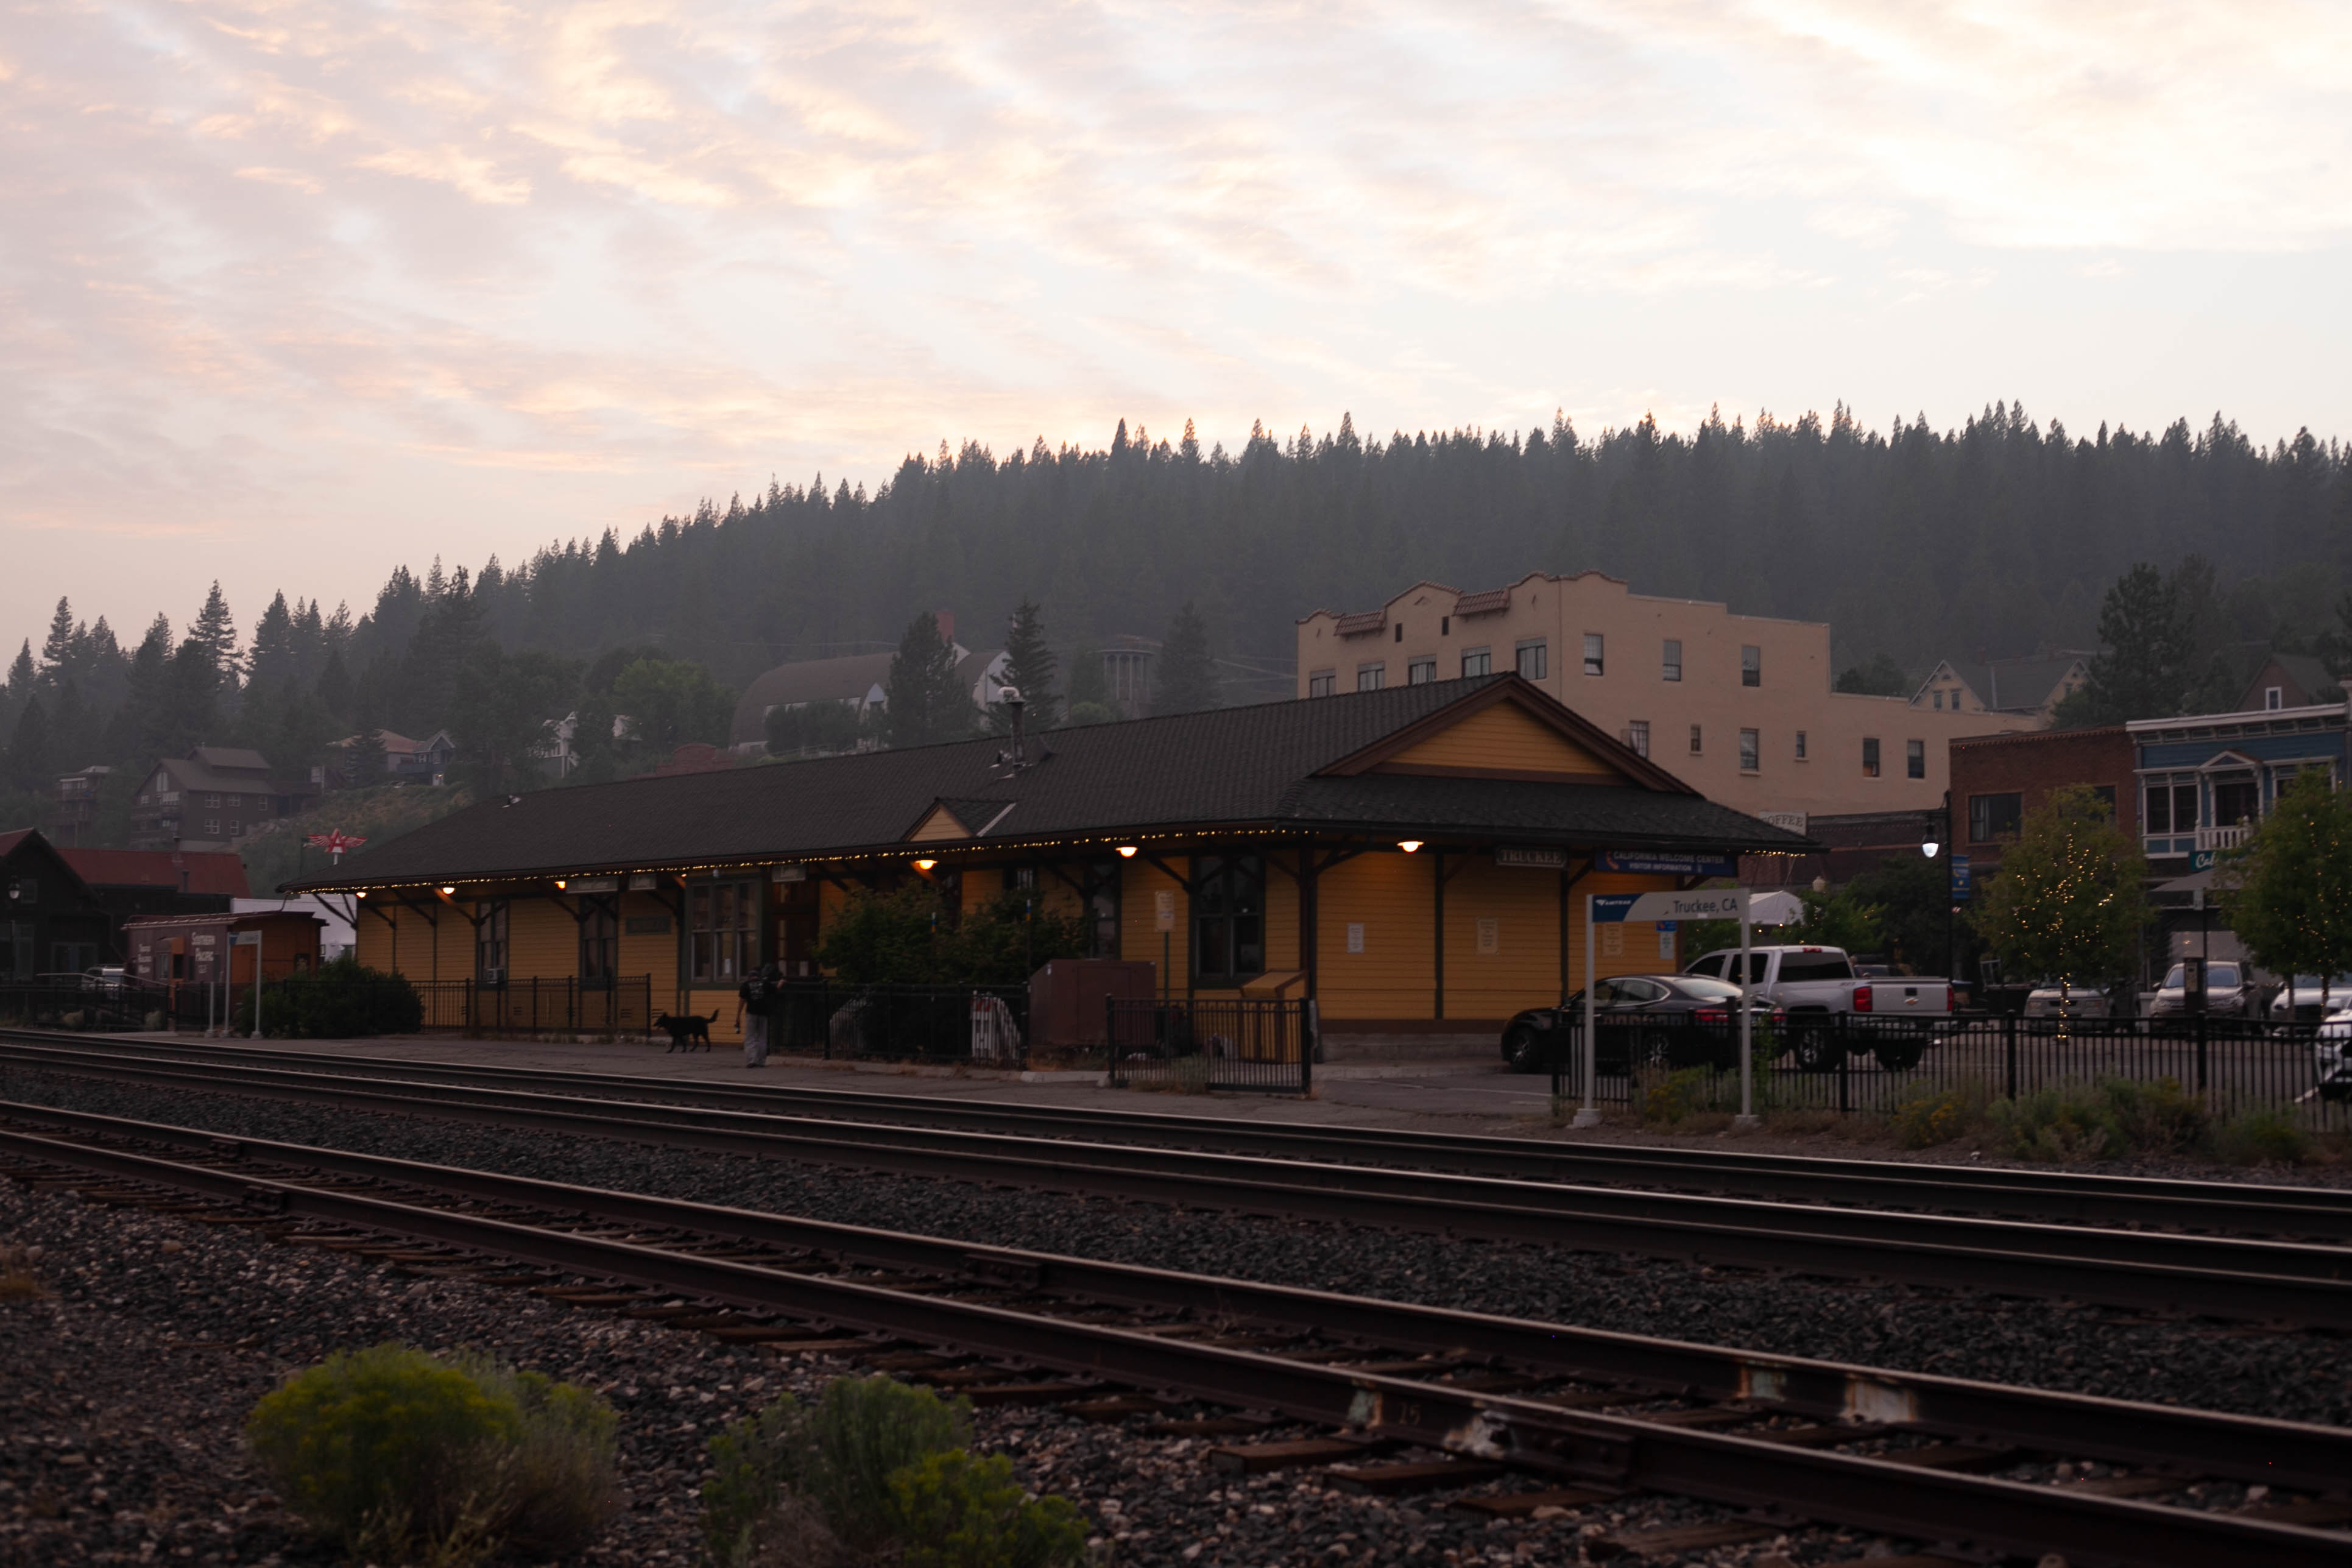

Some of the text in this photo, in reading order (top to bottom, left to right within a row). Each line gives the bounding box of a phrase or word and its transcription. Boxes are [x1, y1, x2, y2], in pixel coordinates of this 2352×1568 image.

[1763, 814, 1804, 827] OFFEE
[1501, 848, 1562, 864] TRUCKEE
[1613, 851, 1725, 864] CALIFORNIA WELCOME CENTER
[1673, 898, 1739, 913] Truckee, CA
